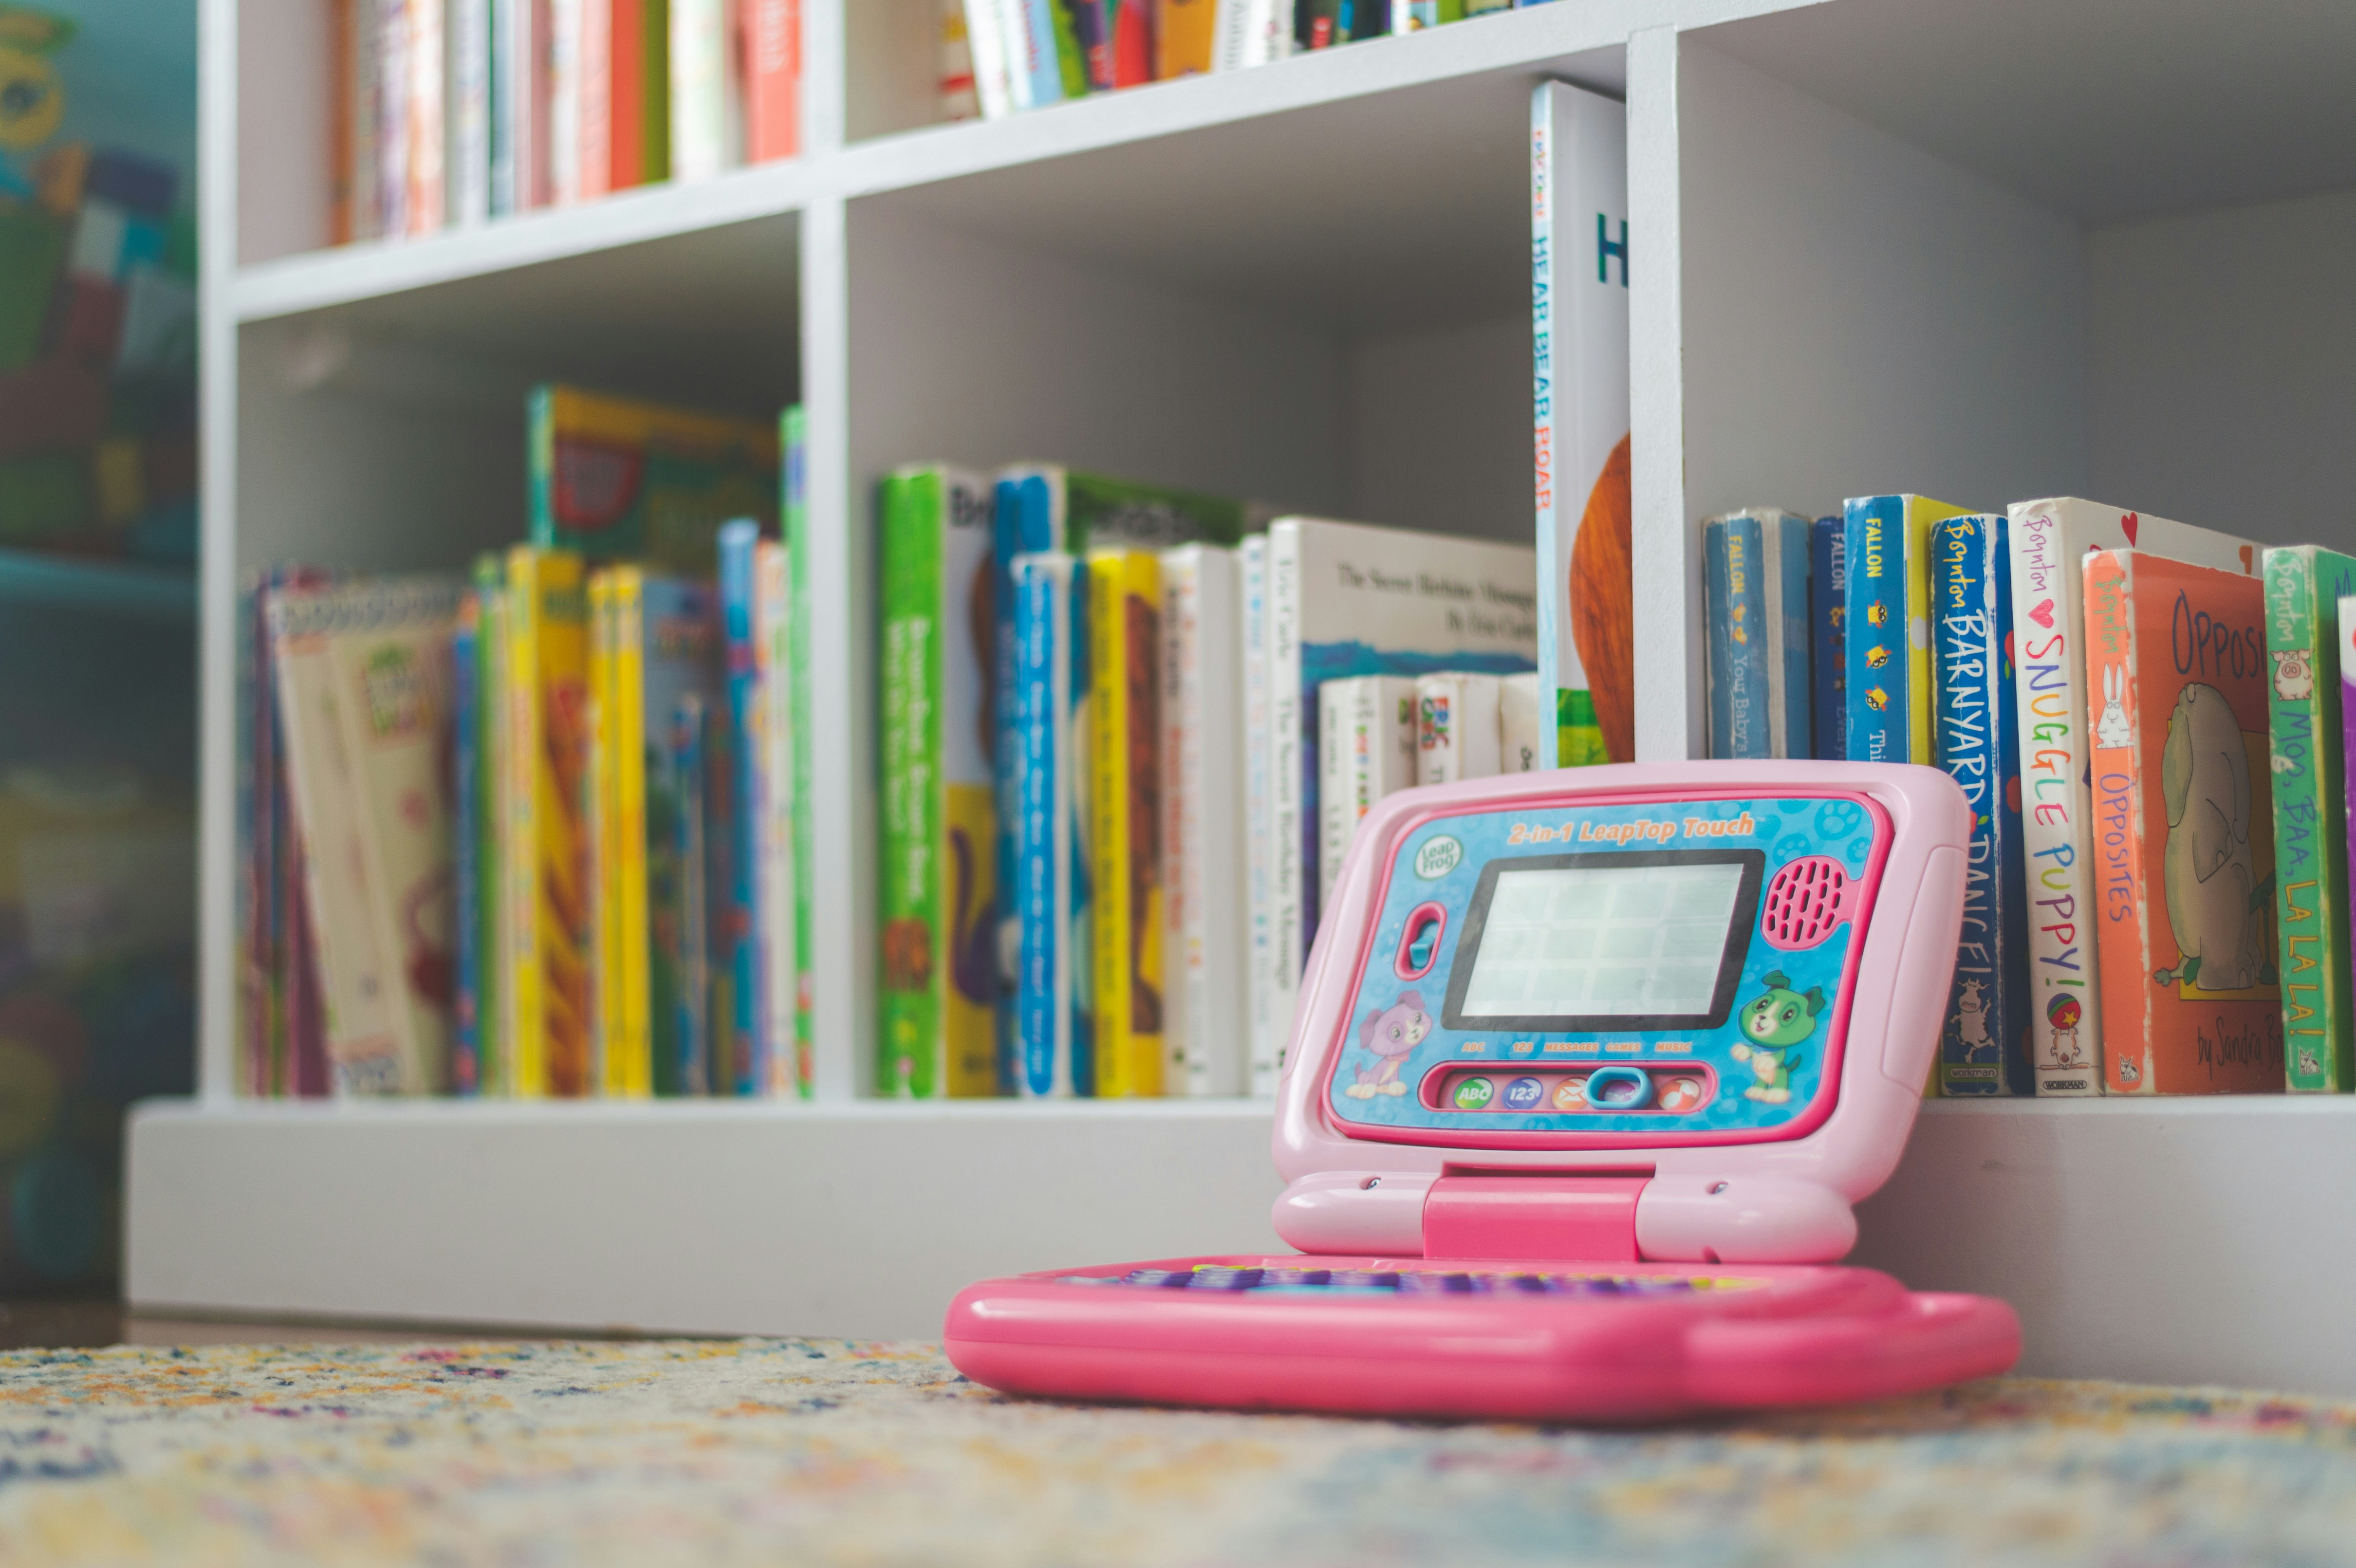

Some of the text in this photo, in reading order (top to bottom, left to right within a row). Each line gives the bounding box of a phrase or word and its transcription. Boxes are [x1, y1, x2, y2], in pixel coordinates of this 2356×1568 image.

[1532, 235, 1552, 513] HEAR BEAR ROAR
[1728, 535, 1744, 594] FALLON
[1831, 533, 1845, 591] FALLON
[1865, 518, 1882, 578] FALLON
[1943, 519, 1977, 609] Boynton
[2022, 515, 2056, 592] Boynton
[2094, 575, 2126, 654] Boynton
[2270, 557, 2305, 643] Boynton
[2172, 588, 2267, 680] OPPOSI
[1734, 655, 1751, 753] Your Baby's
[1942, 609, 1987, 805] BARNYARD
[1869, 729, 1886, 762] Thi
[1509, 823, 1572, 845] 2-in-1
[1579, 819, 1675, 845] LeapTop
[1684, 812, 1754, 838] Touch
[2024, 634, 2085, 987] SNUGGLE PUPPY!
[2283, 795, 2317, 877] BAA,
[1422, 841, 1453, 860] Leap
[1422, 855, 1454, 873] Frog
[2100, 773, 2135, 922] OPPOSITES
[2284, 880, 2318, 923] LA
[2288, 935, 2319, 974] LA
[2287, 984, 2326, 1036] LA!
[1462, 1041, 1691, 1052] ABC 123 MESSAGES GAMES MUSIC
[1952, 1068, 1996, 1077] workman
[2197, 1014, 2283, 1081] by Sandra Bo
[1458, 1087, 1537, 1101] ABC 123
[2045, 1080, 2085, 1089] WORKMAN
